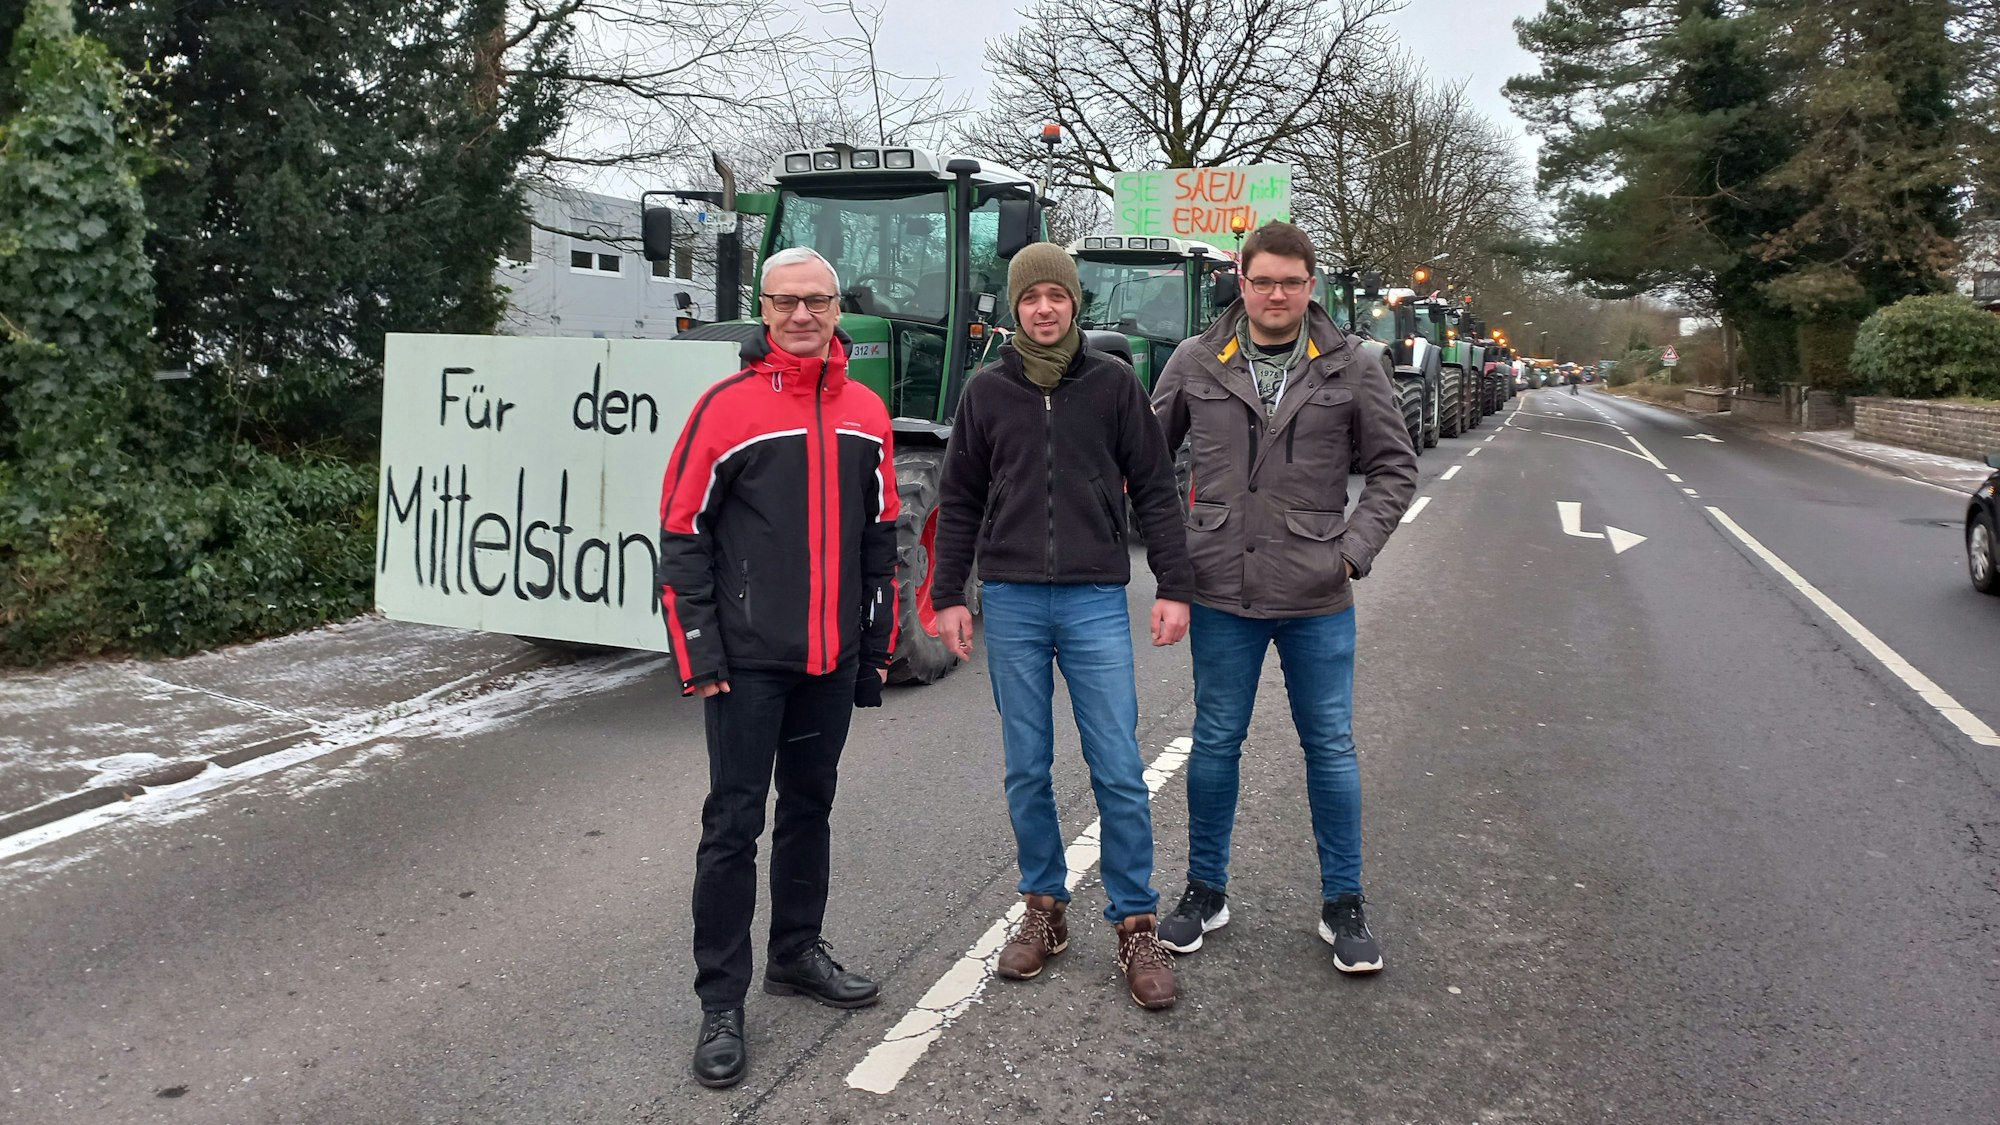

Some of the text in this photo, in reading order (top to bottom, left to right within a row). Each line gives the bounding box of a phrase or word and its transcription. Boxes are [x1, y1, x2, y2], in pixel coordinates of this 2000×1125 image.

[1120, 175, 1163, 204] SIE
[1175, 167, 1246, 202] SÄEN
[1121, 207, 1163, 234] SIE
[854, 345, 868, 356] 312
[440, 362, 659, 435] Für den
[381, 464, 659, 616] Mittelstan
